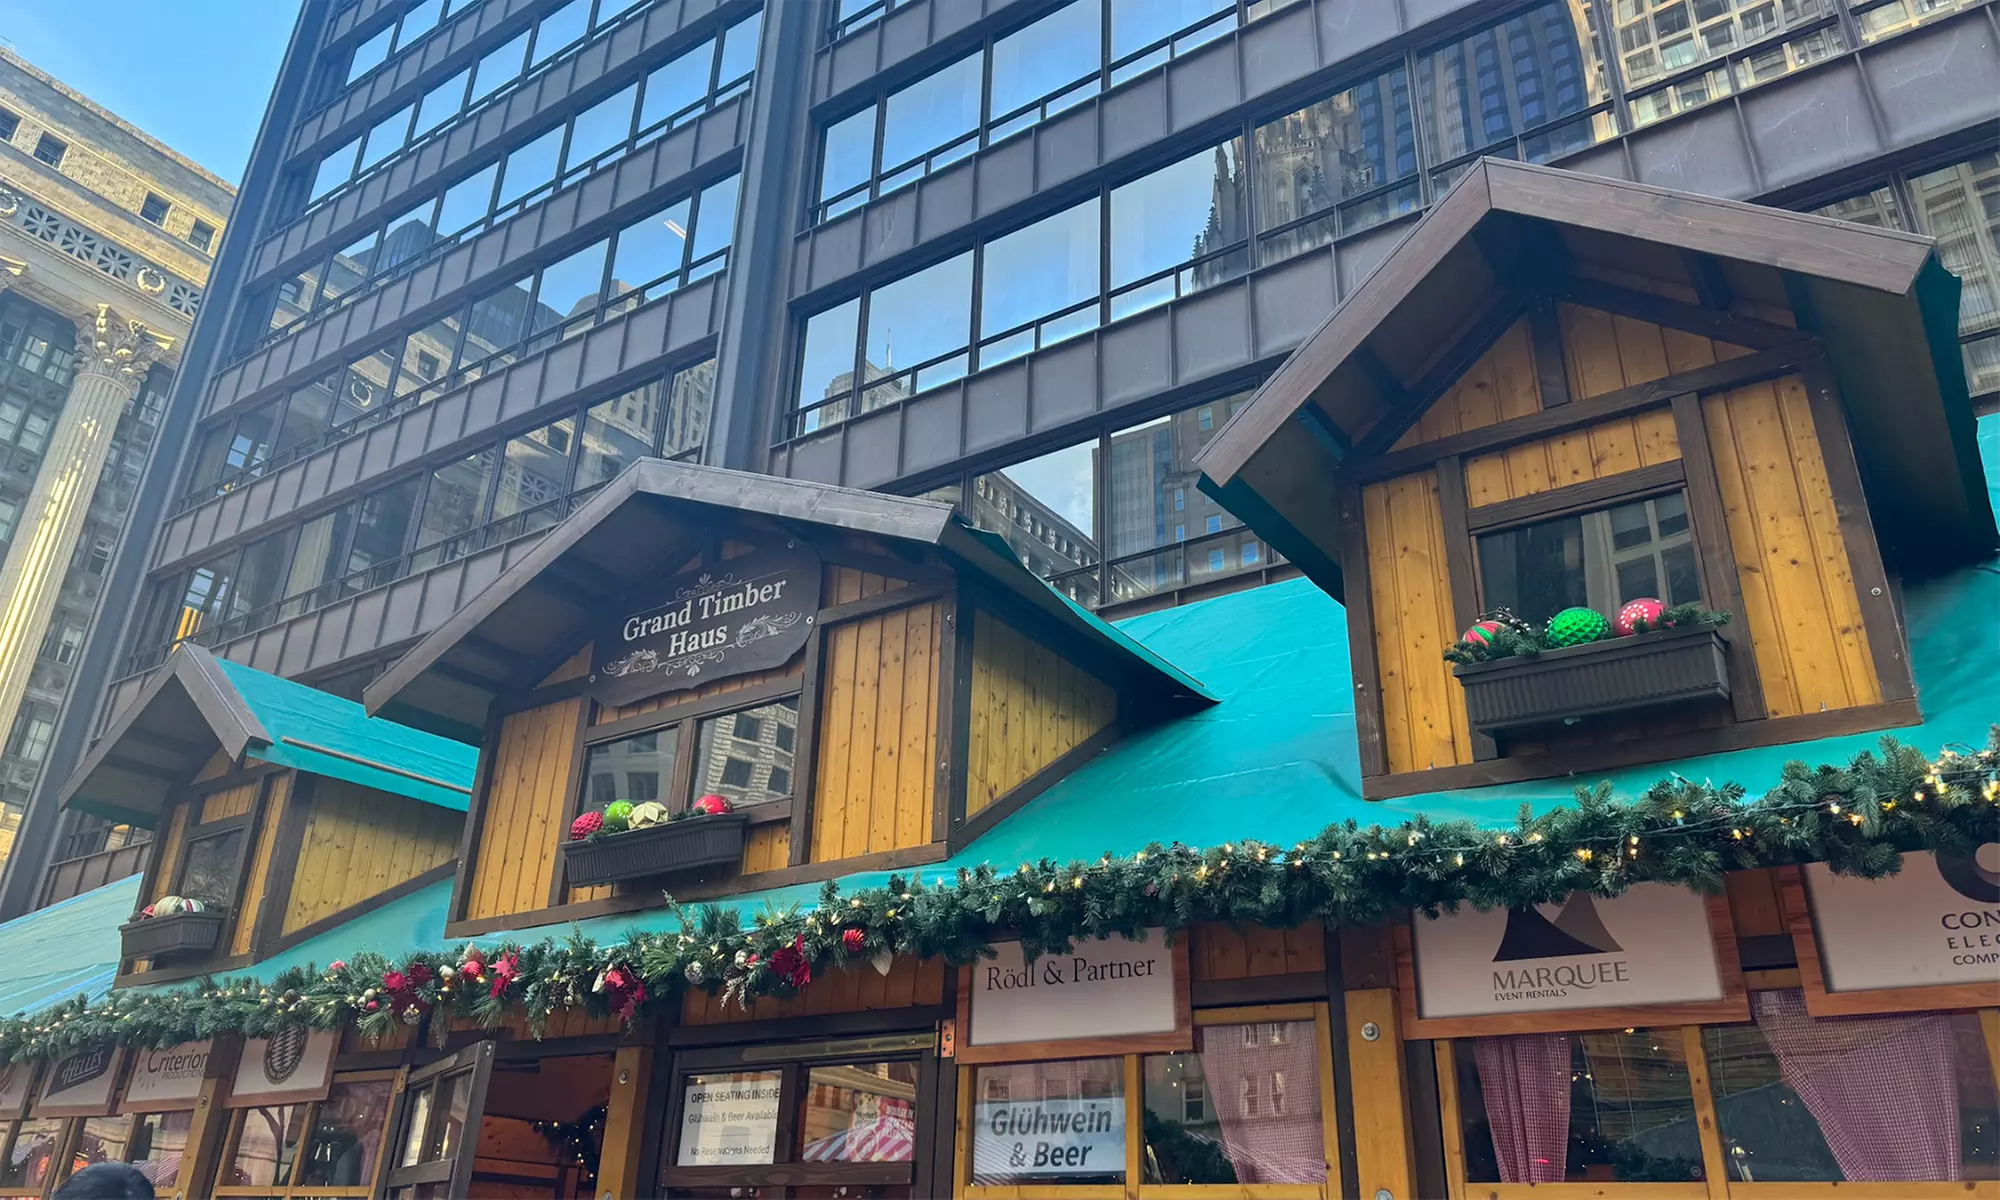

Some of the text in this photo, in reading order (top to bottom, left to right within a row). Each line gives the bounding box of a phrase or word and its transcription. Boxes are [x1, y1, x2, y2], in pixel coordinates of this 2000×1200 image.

[623, 580, 787, 641] Grand Timber
[668, 625, 728, 658] Haus
[986, 957, 1156, 991] Rödl & Partner
[1493, 961, 1629, 990] MARQUEE
[1494, 988, 1567, 1001] EVENT RENTALS
[691, 1088, 780, 1103] OPEN SEATING INSIDE
[728, 1111, 745, 1121] Beer
[991, 1103, 1112, 1136] Glühwein
[690, 1147, 700, 1156] No
[743, 1145, 770, 1154] Needed
[1009, 1141, 1093, 1167] & Beer
